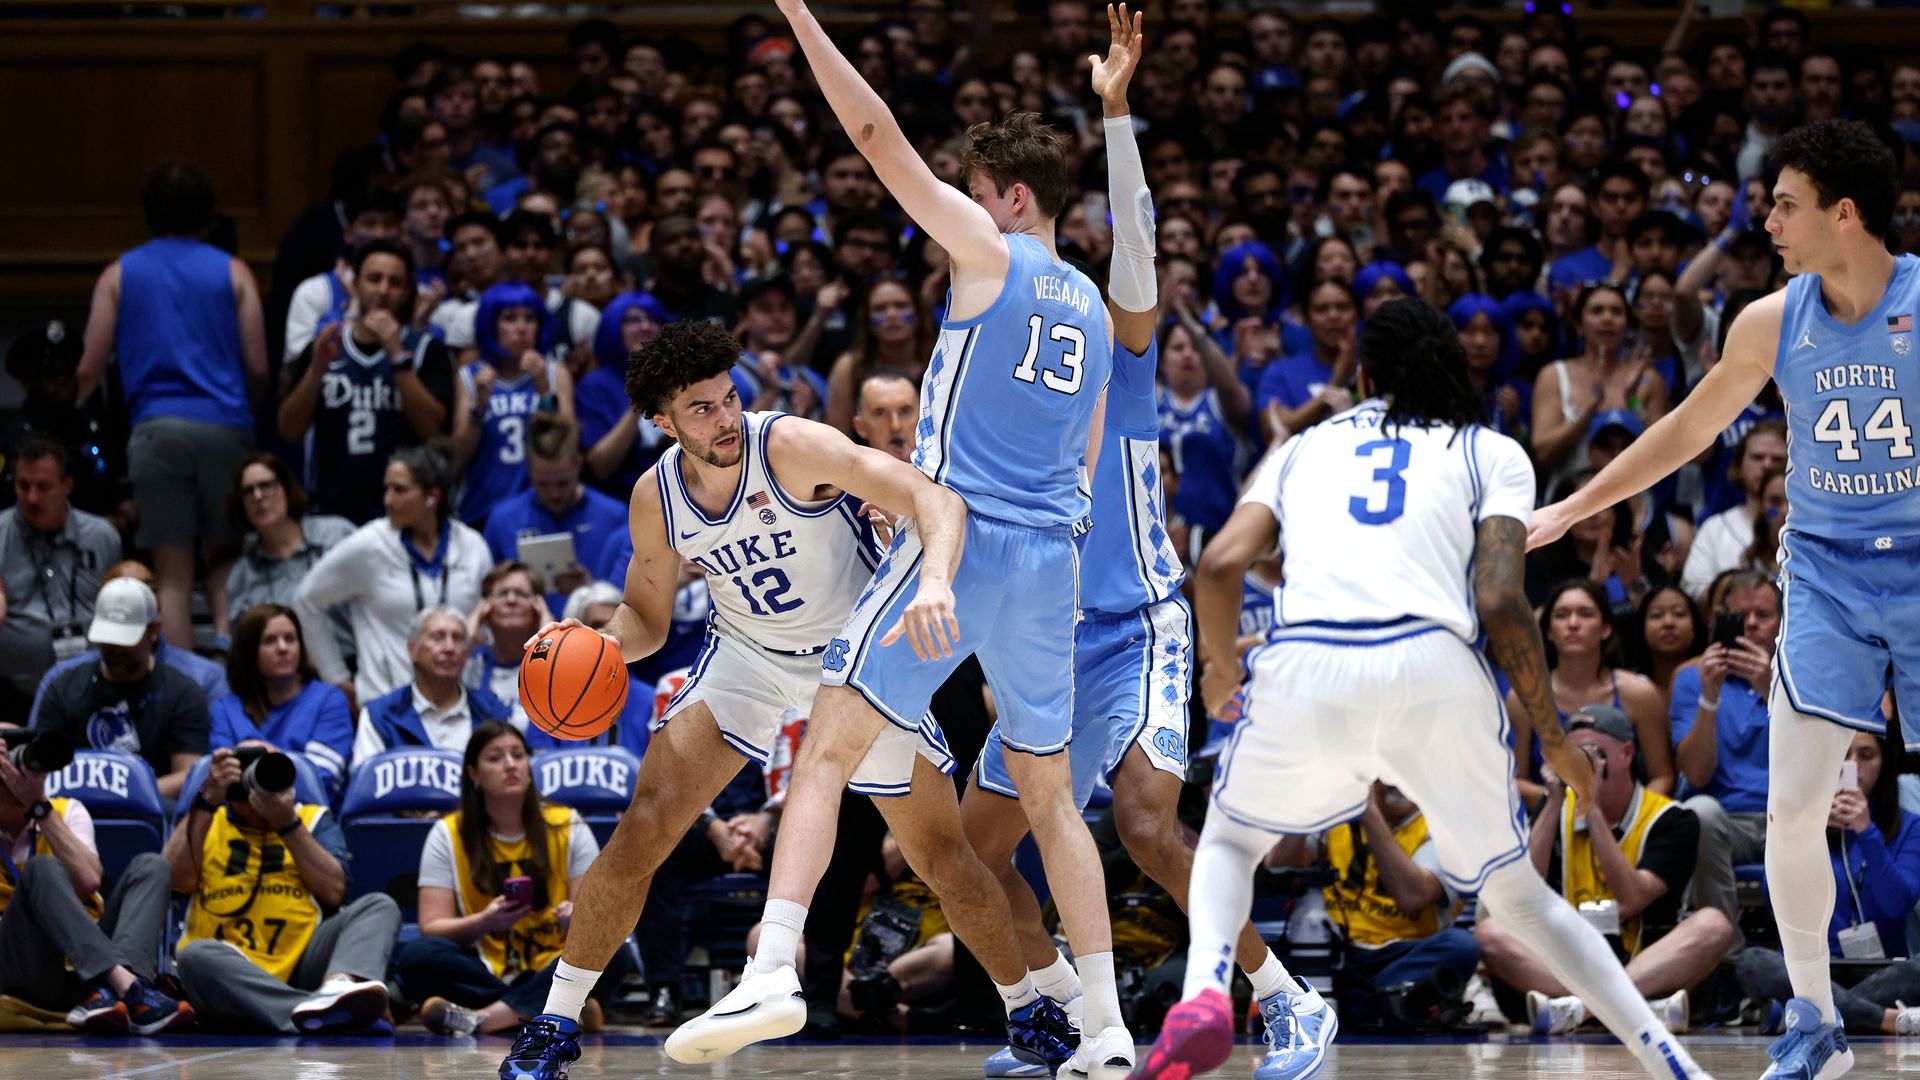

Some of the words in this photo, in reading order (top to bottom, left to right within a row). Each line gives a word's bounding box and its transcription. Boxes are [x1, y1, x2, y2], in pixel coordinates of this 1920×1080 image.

[1033, 275, 1090, 316] VEESAAR
[1012, 313, 1087, 395] 13
[1815, 364, 1897, 394] NORTH
[347, 411, 376, 455] 2
[498, 416, 525, 464] 3
[1813, 396, 1916, 462] 44
[1349, 438, 1412, 525] 3
[690, 530, 797, 577] DUKE
[732, 567, 806, 616] 12
[374, 755, 464, 799] DUKE
[541, 754, 630, 797] DUKE
